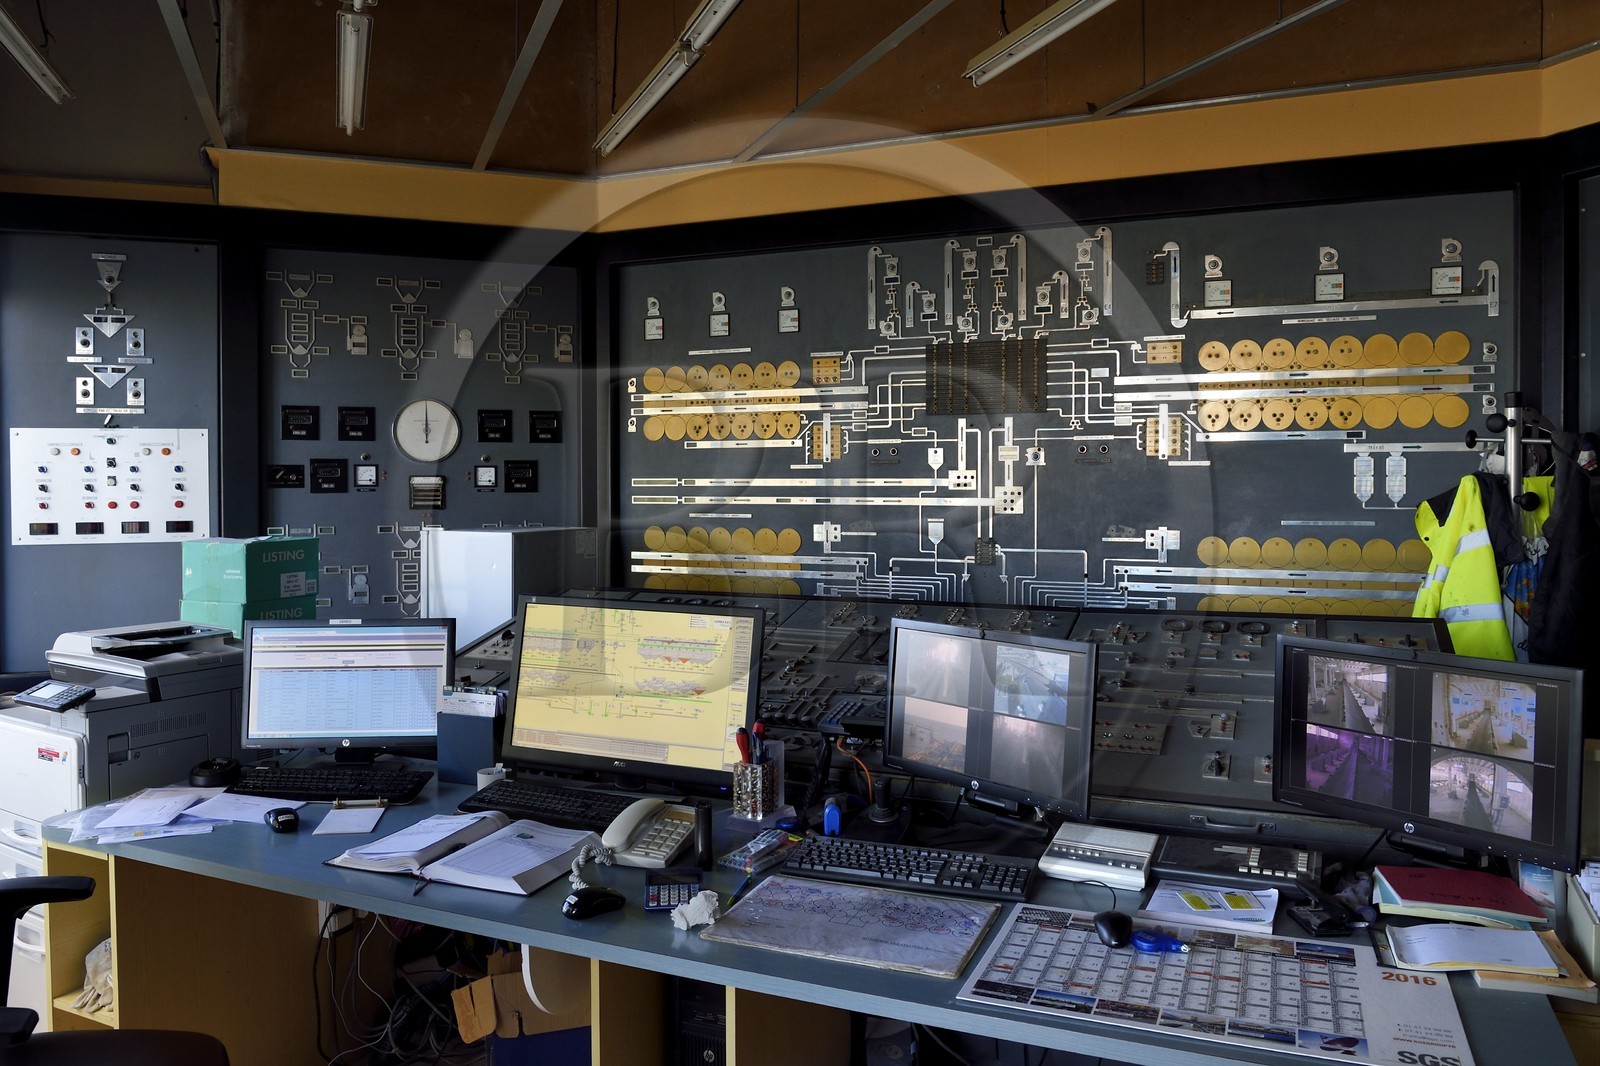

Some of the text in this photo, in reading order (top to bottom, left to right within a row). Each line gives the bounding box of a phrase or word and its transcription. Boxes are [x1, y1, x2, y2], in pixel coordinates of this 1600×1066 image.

[262, 549, 305, 563] LISTING
[260, 607, 303, 620] LISTING
[1403, 821, 1415, 834] hp
[1381, 971, 1437, 987] 2016
[703, 1049, 715, 1063] hp
[1397, 1050, 1460, 1066] SGS
